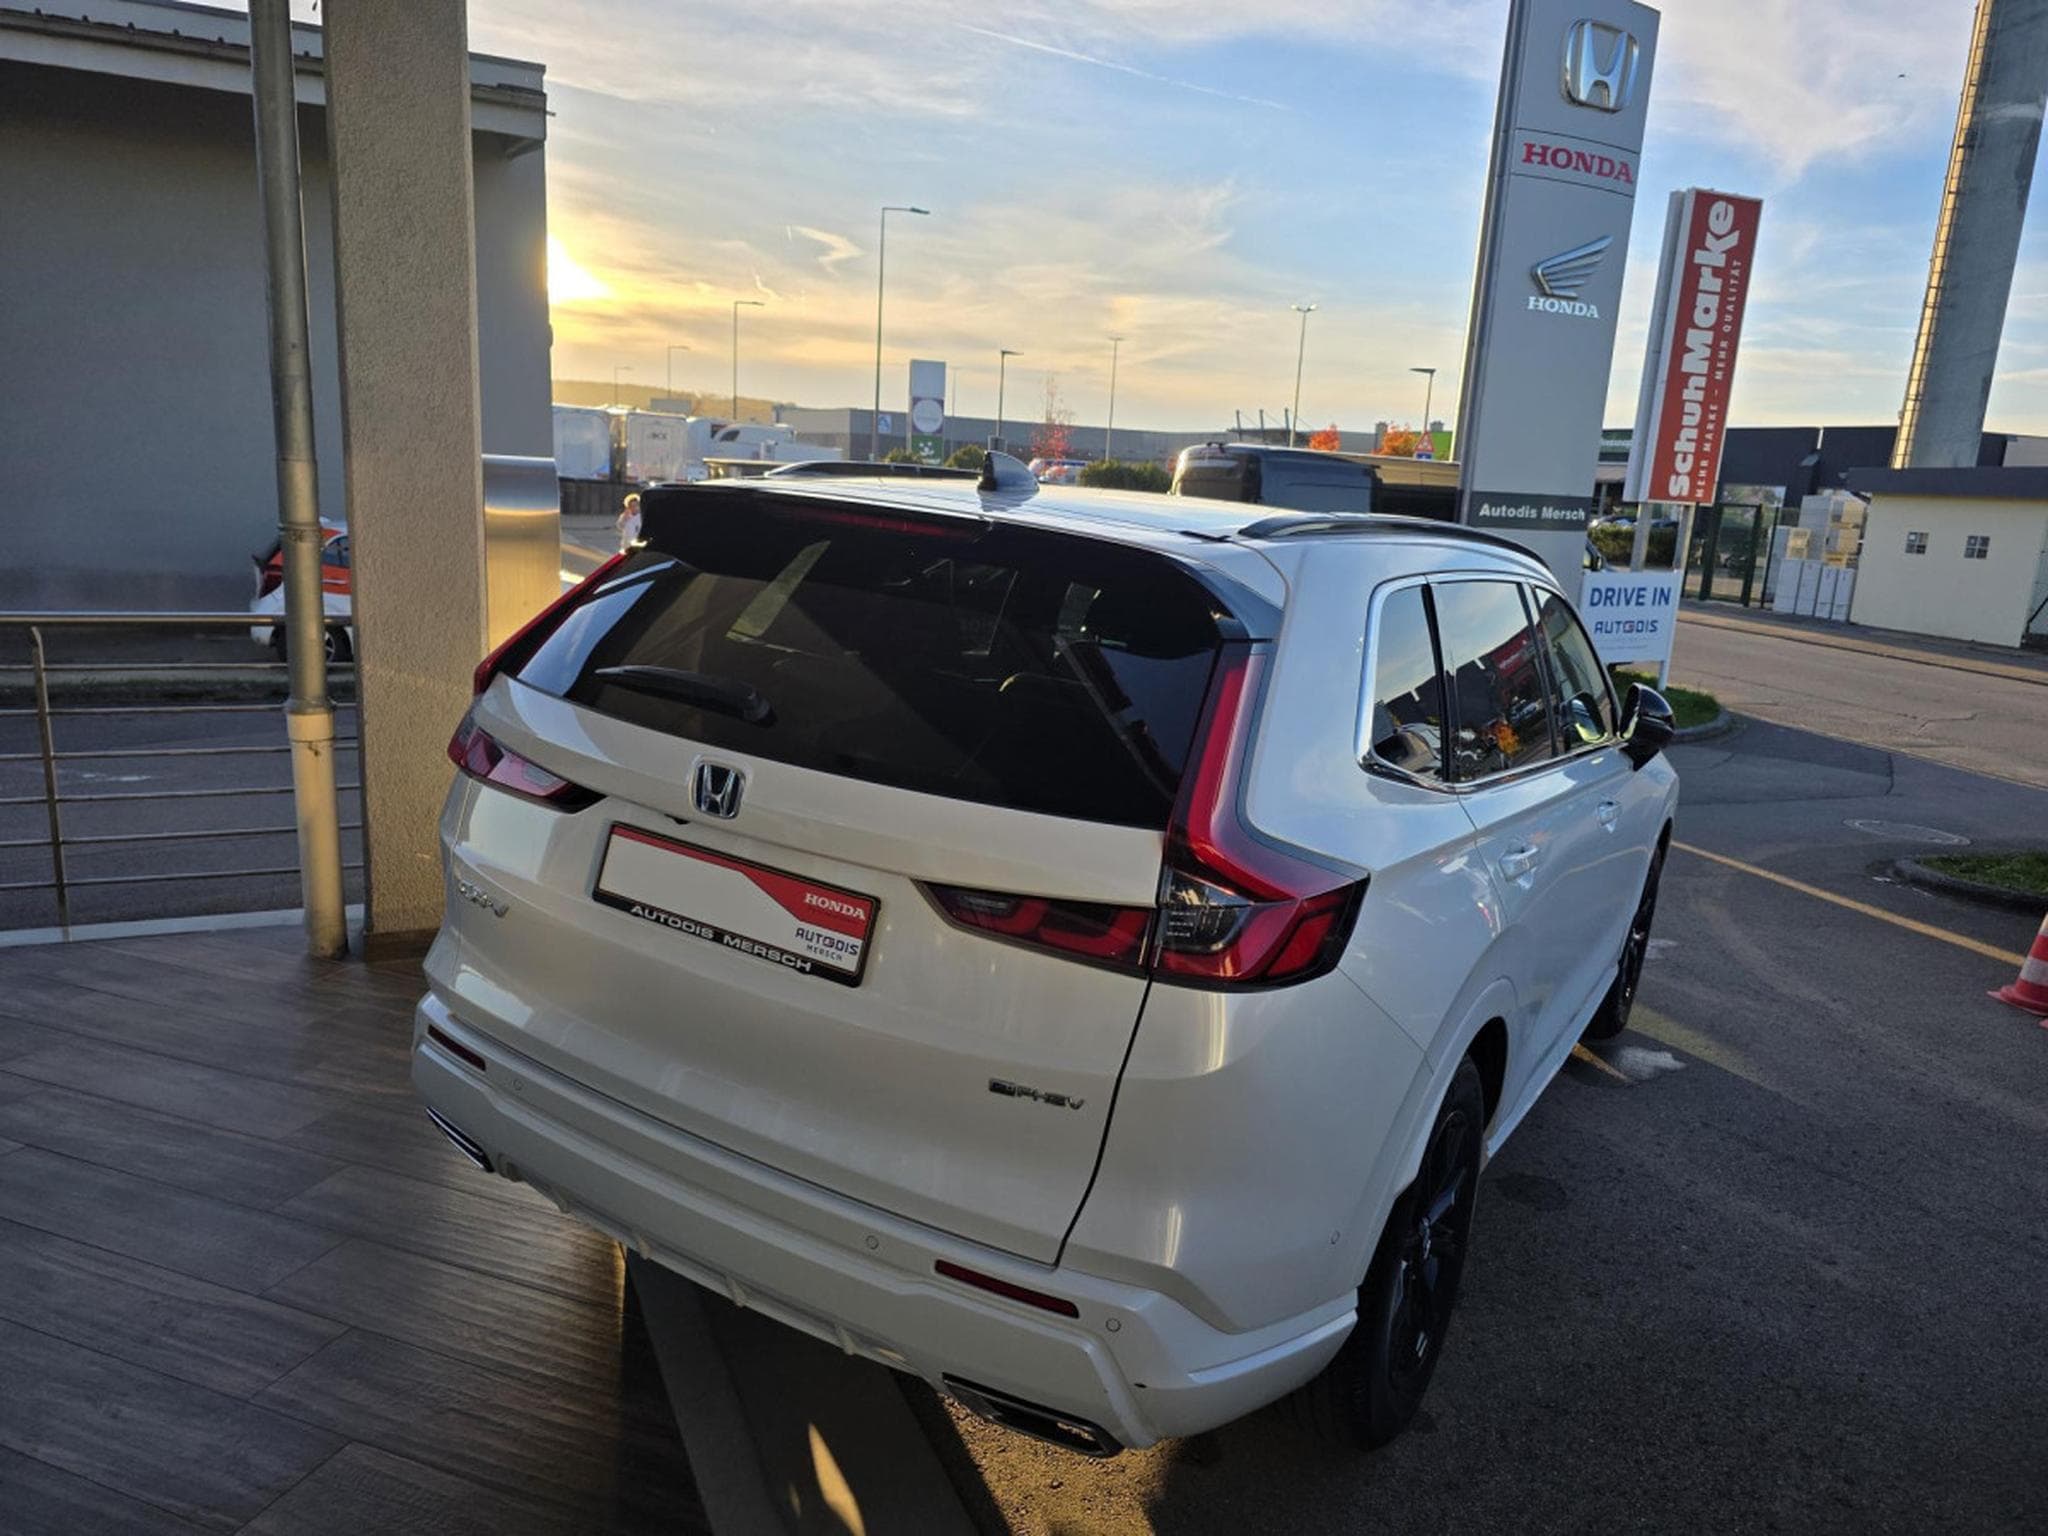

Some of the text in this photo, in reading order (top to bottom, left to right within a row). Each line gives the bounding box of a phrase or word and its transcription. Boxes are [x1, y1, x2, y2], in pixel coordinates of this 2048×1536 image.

[1521, 142, 1633, 184] HONDA
[1527, 296, 1599, 318] HONDA
[1668, 200, 1740, 497] SchuhMarke
[1695, 459, 1709, 498] MEHR
[1703, 404, 1718, 452] MARKE
[1715, 340, 1729, 380] MEHR
[1479, 503, 1586, 520] Autodis Mersch
[1589, 587, 1672, 607] DRIVE IN
[1594, 620, 1659, 634] AUTODIS
[804, 892, 866, 921] HONDA
[630, 905, 812, 973] AUTODIS MERSCH
[795, 927, 859, 957] AUTODIS
